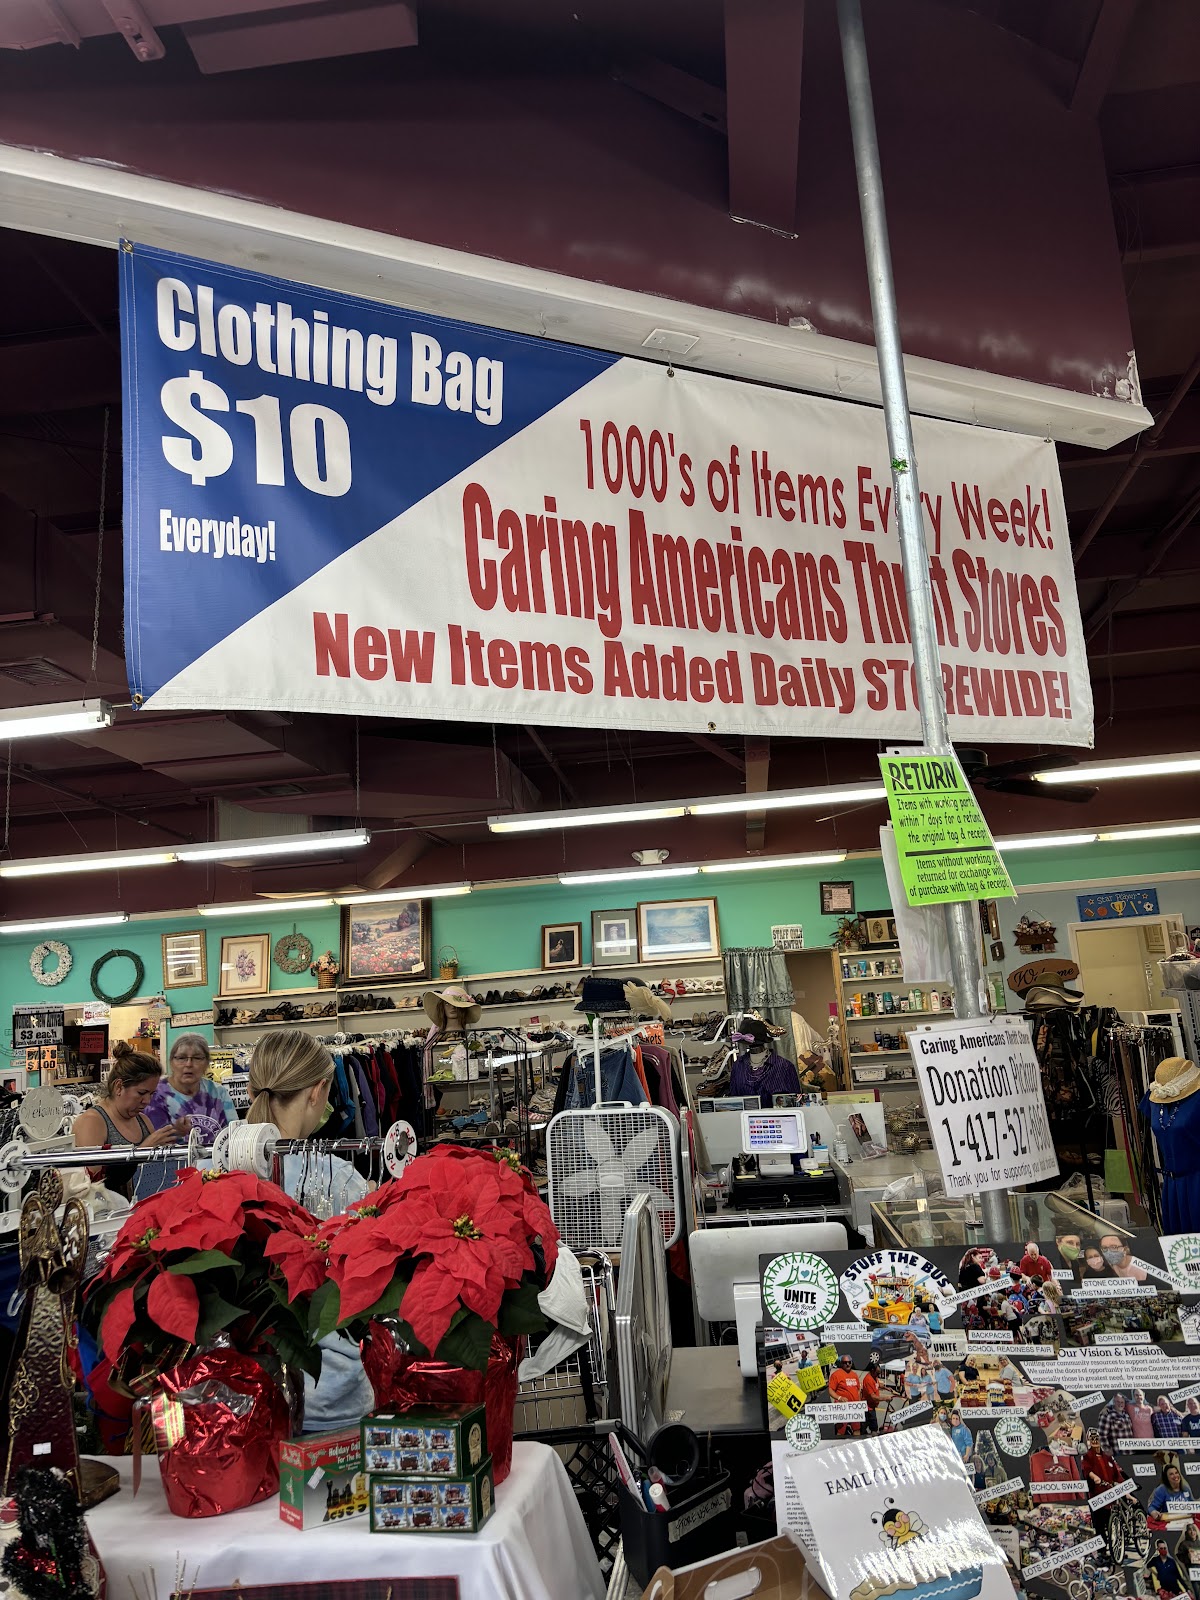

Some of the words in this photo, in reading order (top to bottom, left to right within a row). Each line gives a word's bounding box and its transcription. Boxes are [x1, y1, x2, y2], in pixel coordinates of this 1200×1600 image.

[157, 277, 398, 406] Clothing
[411, 332, 504, 426] Bag
[160, 370, 353, 497] $10
[580, 419, 696, 507] 1000's
[708, 445, 741, 513] of
[752, 450, 847, 530] Items
[857, 465, 942, 554] Evy
[951, 481, 1054, 551] Week!
[159, 509, 276, 563] Everyday!
[462, 482, 623, 639] Caring
[628, 508, 848, 644] Americans
[952, 548, 1067, 658] Stores
[313, 611, 436, 684] New
[448, 623, 594, 696] Items
[604, 640, 744, 706] Added
[752, 653, 855, 715] Daily
[862, 658, 1073, 720] STREWIDE!
[888, 761, 958, 791] RETURN
[897, 799, 917, 811] Items
[919, 797, 933, 809] with
[935, 796, 958, 811] working
[899, 814, 919, 827] within
[920, 813, 925, 826] 7
[928, 813, 942, 829] days
[944, 812, 954, 825] for
[908, 831, 920, 843] the
[922, 829, 945, 845] original
[947, 829, 958, 844] tag
[916, 857, 937, 870] Items
[938, 855, 964, 868] without
[964, 854, 991, 867] working
[917, 870, 946, 883] returned
[948, 868, 958, 880] for
[960, 866, 991, 879] exchange
[910, 885, 918, 897] of
[918, 884, 950, 898] purchase
[950, 882, 966, 894] with
[967, 881, 978, 893] tag
[773, 928, 789, 939] STAFF
[784, 940, 802, 949] ENTRY
[21, 1030, 33, 1040] $3
[36, 1029, 57, 1039] each
[920, 1038, 958, 1055] Caring
[960, 1032, 1006, 1051] Americans
[926, 1056, 1013, 1106] Donation
[1008, 1052, 1039, 1103] Pickup
[947, 1172, 972, 1188] Thank
[974, 1171, 989, 1188] you
[991, 1166, 1001, 1182] for
[1003, 1161, 1032, 1180] supporting
[845, 1252, 883, 1281] STUFF
[888, 1251, 919, 1266] THE
[921, 1261, 950, 1288] BUS
[1132, 1259, 1157, 1274] ADOPT
[1162, 1274, 1188, 1288] FAMILY
[784, 1289, 817, 1305] UNITE
[941, 1289, 977, 1306] COMMUNITY
[977, 1278, 1010, 1294] PARTNERS
[1073, 1289, 1112, 1297] CHRISTMAS
[1113, 1287, 1155, 1296] ASSISTANCE
[800, 1303, 817, 1311] Rock
[846, 1323, 857, 1331] ALL
[836, 1333, 872, 1341] TOGETHER
[1129, 1333, 1149, 1341] TOYS
[933, 1342, 958, 1353] UNITE
[1059, 1348, 1078, 1358] Our
[1079, 1347, 1112, 1358] Vision
[1114, 1347, 1122, 1357] &
[1124, 1346, 1164, 1357] Mission
[1023, 1360, 1046, 1368] Uniting
[1056, 1360, 1090, 1368] community
[1125, 1358, 1148, 1366] support
[1088, 1366, 1123, 1374] opportunity
[767, 1373, 786, 1398] UNITE
[1033, 1375, 1061, 1383] especially
[1083, 1374, 1108, 1382] greatest
[1135, 1373, 1159, 1381] creating
[848, 1402, 867, 1410] FOOD
[1071, 1393, 1102, 1410] SUPPORT
[818, 1413, 863, 1421] DISTRIBUTION
[891, 1400, 932, 1422] COMPASSION
[962, 1408, 989, 1416] SCHOOL
[991, 1407, 1025, 1415] SUPPLIES
[796, 1432, 811, 1440] UNITE
[1006, 1435, 1022, 1443] UNITE
[329, 1443, 349, 1457] Holiday
[346, 1454, 355, 1462] The
[1135, 1466, 1155, 1474] LOVE
[991, 1479, 1021, 1496] RESULTS
[1031, 1484, 1061, 1492] SCHOOL
[1061, 1483, 1085, 1491] SWAG!
[1092, 1497, 1104, 1508] BIG
[1104, 1491, 1115, 1502] KID
[1115, 1481, 1135, 1497] BIKES
[676, 1511, 697, 1530] STORE
[1023, 1565, 1040, 1578] LOTS
[1041, 1560, 1052, 1571] OF
[1053, 1547, 1088, 1566] DONATED
[1088, 1538, 1104, 1553] TOYS
